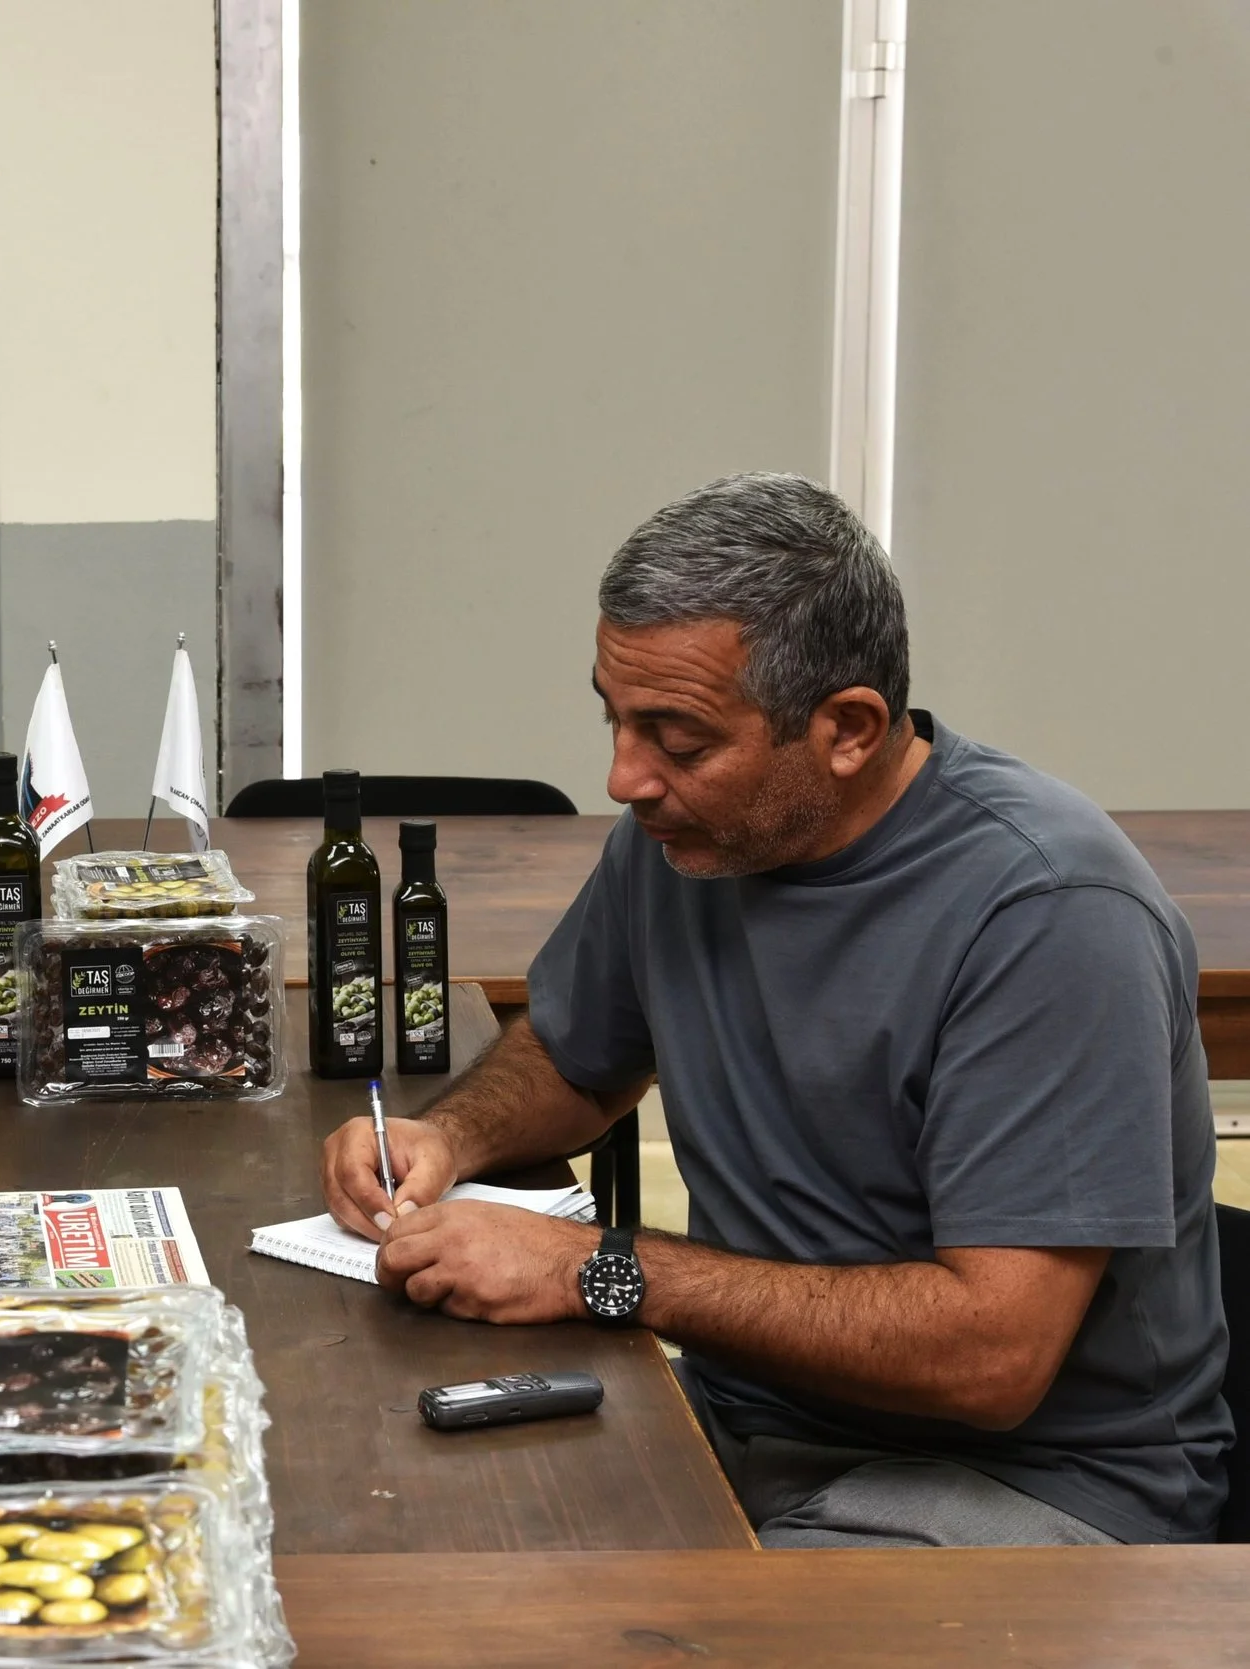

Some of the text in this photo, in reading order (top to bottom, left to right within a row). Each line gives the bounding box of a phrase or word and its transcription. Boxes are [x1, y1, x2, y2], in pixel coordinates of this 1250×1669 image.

[41, 803, 81, 838] ZANAATKARLAR
[0, 887, 20, 904] TAŞ
[349, 903, 366, 916] TAŞ
[417, 921, 434, 934] TAŞ
[86, 970, 109, 987] TAŞ
[77, 986, 109, 995] DEĞİRMEN
[78, 1003, 129, 1016] ZEYTİN
[56, 1211, 105, 1268] ÜRETİM
